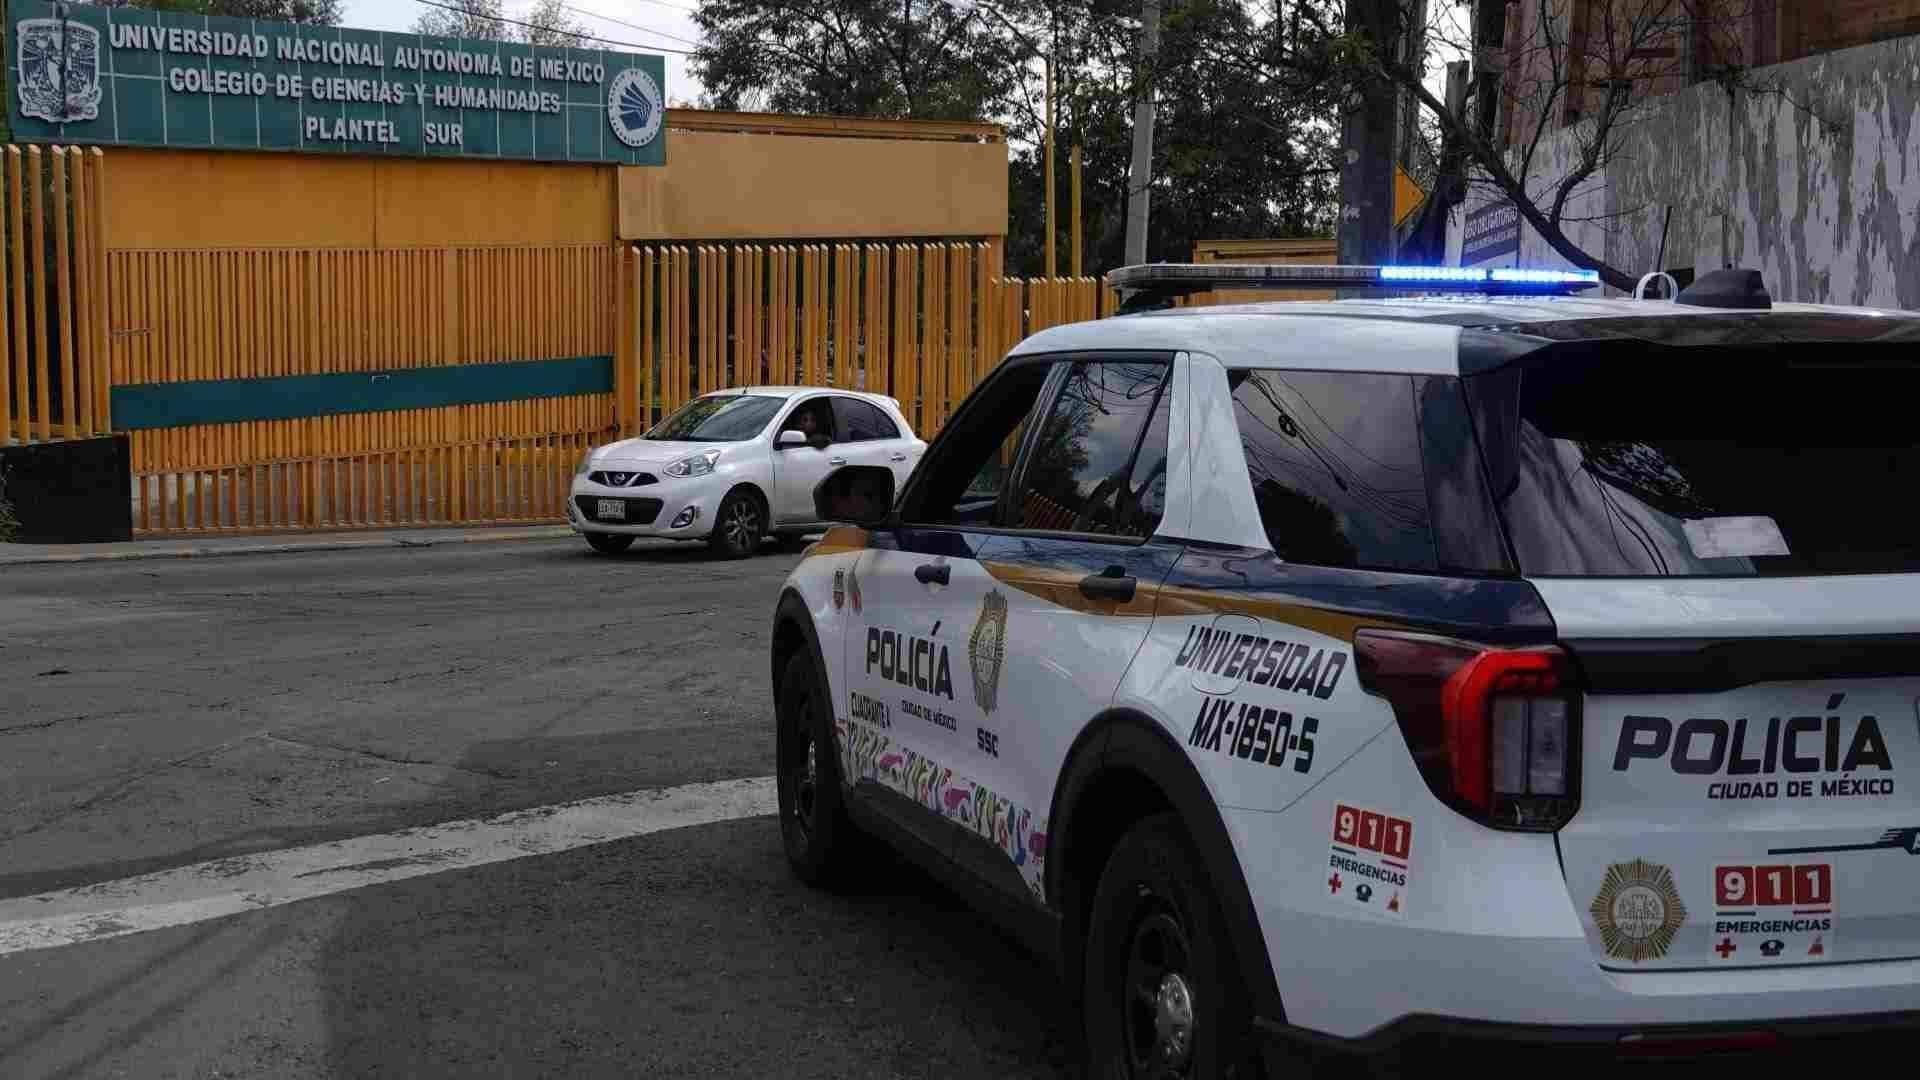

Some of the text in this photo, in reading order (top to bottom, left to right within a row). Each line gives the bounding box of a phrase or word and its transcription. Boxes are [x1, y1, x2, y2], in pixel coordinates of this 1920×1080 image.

[109, 23, 269, 59] UNIVERSIDAD
[277, 36, 385, 67] NACIONAL
[393, 47, 504, 77] AUTONOMA
[511, 55, 535, 79] DE
[169, 67, 561, 113] COLEGIO DE CIENCIAS Y HUMANIDADES
[305, 116, 463, 146] PLANTEL SUR
[866, 620, 954, 701] POLICÍA
[1175, 624, 1348, 701] UNIVERSIDAD
[901, 699, 922, 718] CIUDAD
[923, 705, 933, 722] DE
[976, 727, 999, 759] SSC
[1612, 693, 1894, 776] POLICÍA
[1707, 773, 1894, 800] CIUDAD DE MÉXICO
[1338, 811, 1405, 853] 911
[1330, 854, 1407, 886] EMERGENCIAS
[1723, 869, 1821, 900] 911
[1715, 918, 1831, 934] EMERGENCIAS
